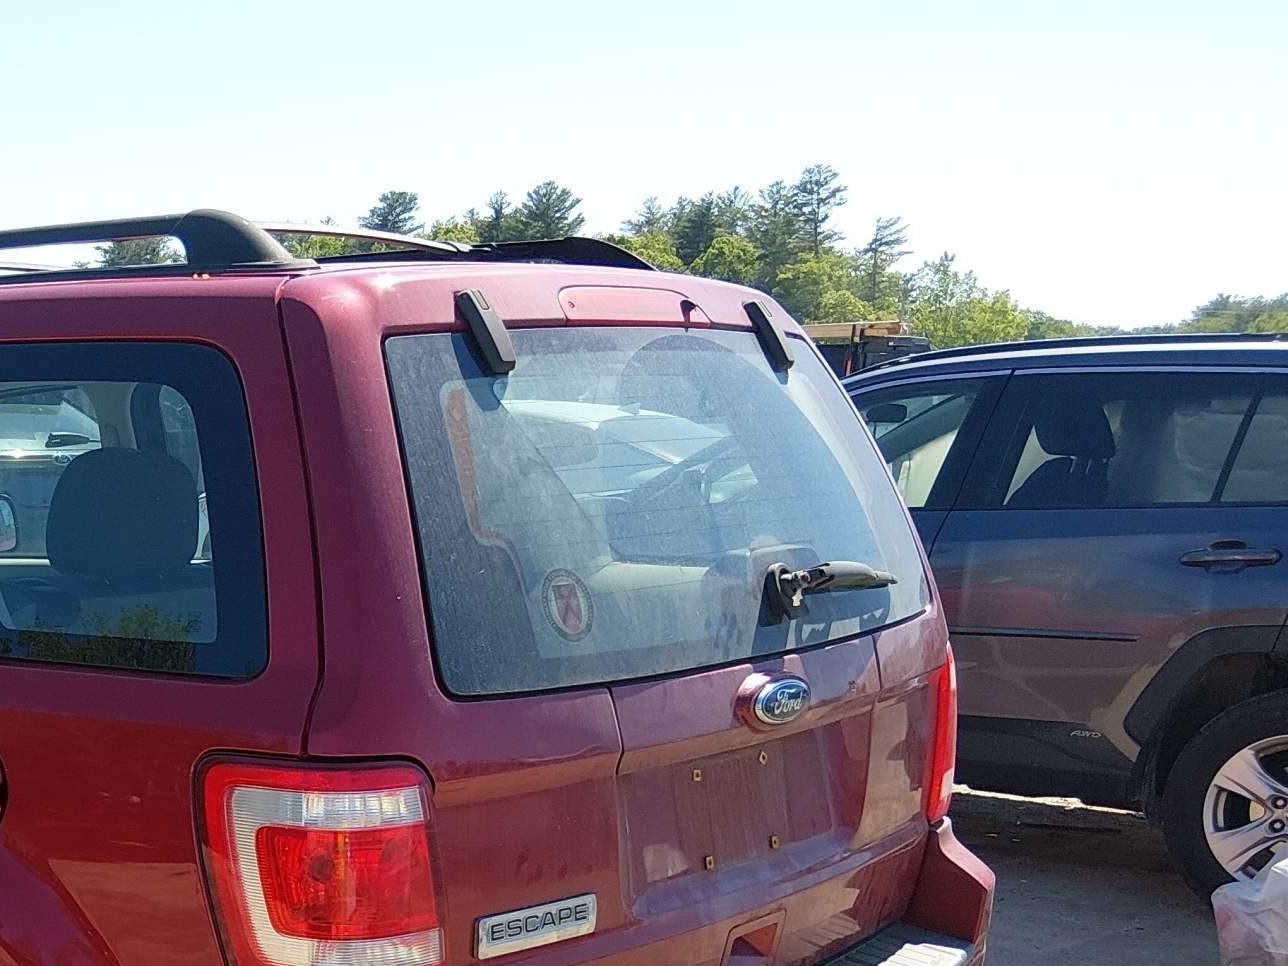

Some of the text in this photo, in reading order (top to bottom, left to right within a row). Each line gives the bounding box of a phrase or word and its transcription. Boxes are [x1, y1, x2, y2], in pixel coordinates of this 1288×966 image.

[773, 687, 804, 715] Ford
[1069, 729, 1102, 738] AWD
[490, 903, 587, 942] ESCAPE
